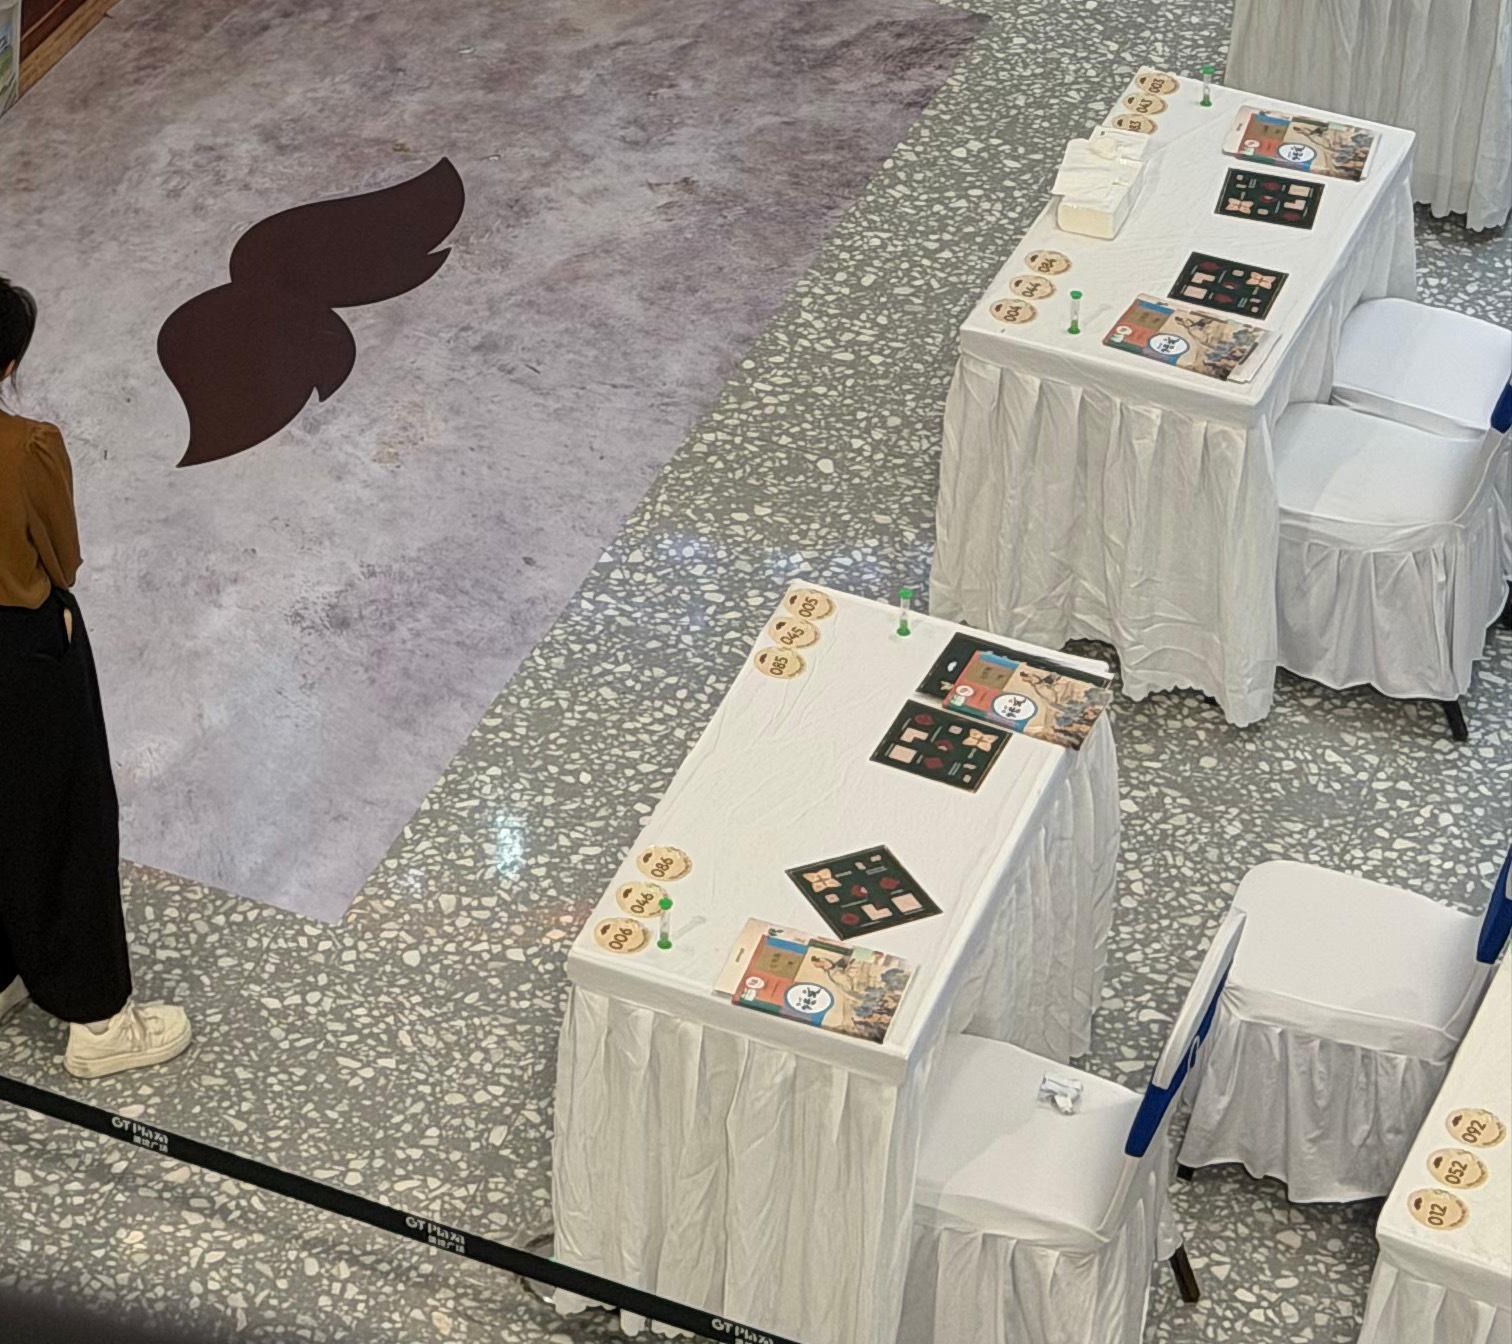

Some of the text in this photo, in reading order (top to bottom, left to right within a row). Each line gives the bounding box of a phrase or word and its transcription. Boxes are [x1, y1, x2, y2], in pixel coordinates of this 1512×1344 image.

[798, 597, 819, 619] 005
[780, 626, 806, 646] 045
[769, 655, 788, 676] 085
[651, 856, 675, 879] 086
[630, 891, 655, 915] 046
[608, 927, 634, 951] 006
[1461, 1119, 1486, 1143] 092
[1444, 1160, 1468, 1185] 052
[1428, 1203, 1448, 1226] 012
